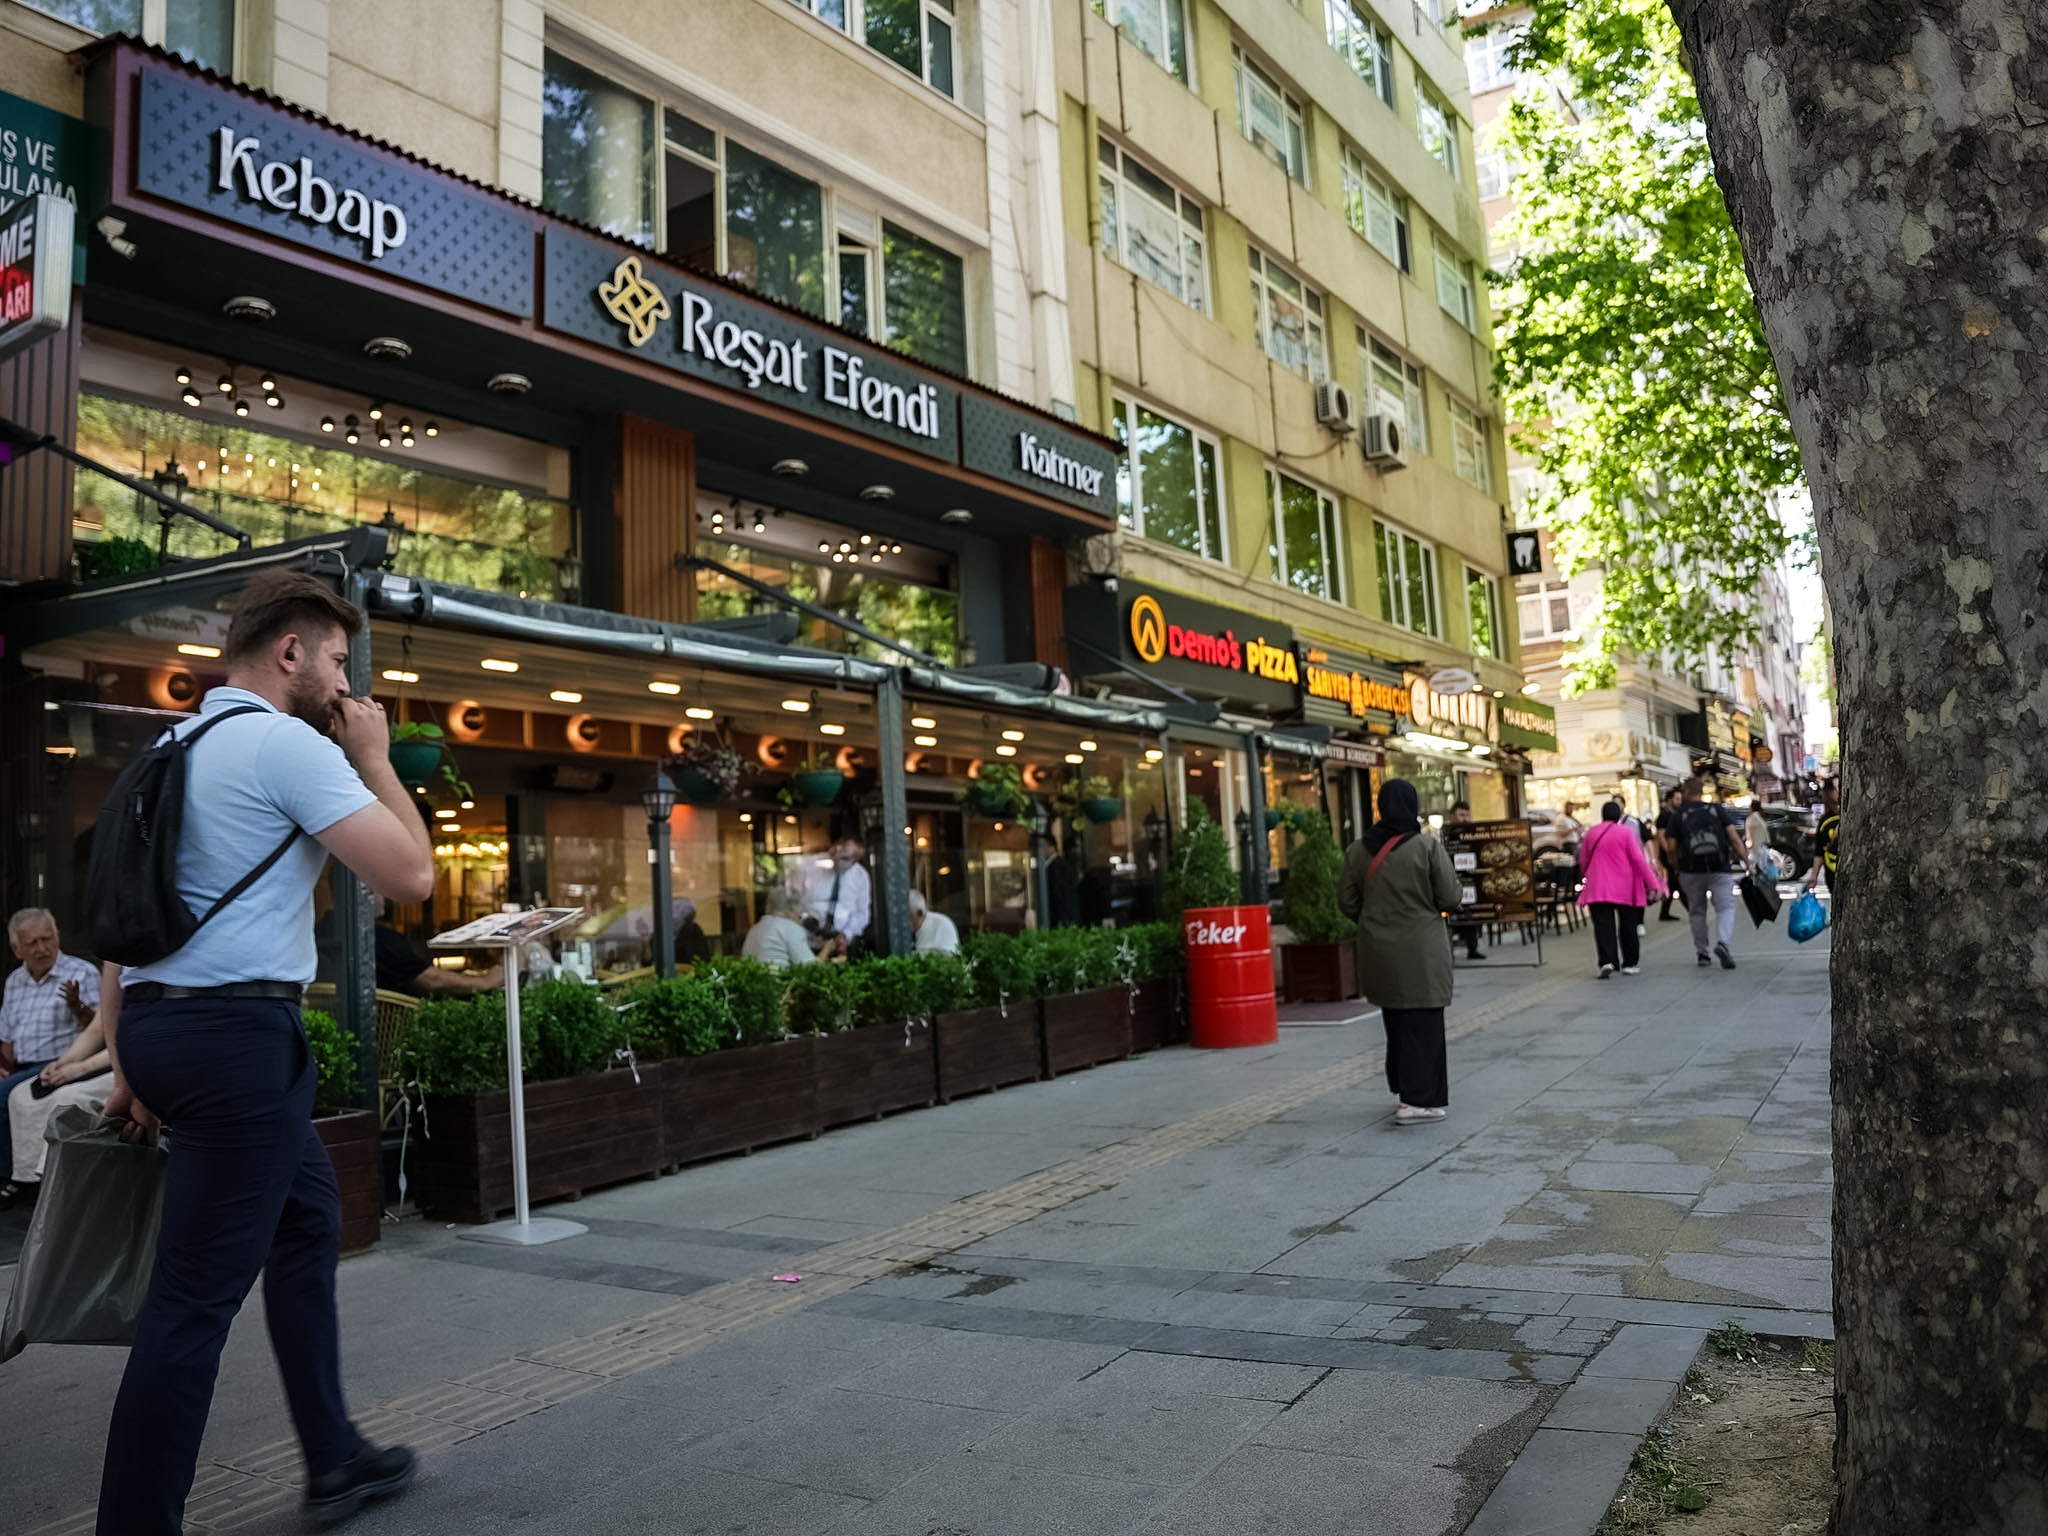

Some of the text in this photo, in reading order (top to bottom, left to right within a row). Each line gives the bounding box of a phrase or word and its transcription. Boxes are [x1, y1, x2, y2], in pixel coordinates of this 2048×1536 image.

[25, 136, 56, 173] VE
[218, 125, 408, 259] Kebap
[681, 290, 940, 440] Reşat Efendi
[1020, 431, 1104, 496] Katmer
[1168, 624, 1242, 671] Demo's
[1307, 666, 1350, 702] SARIYER
